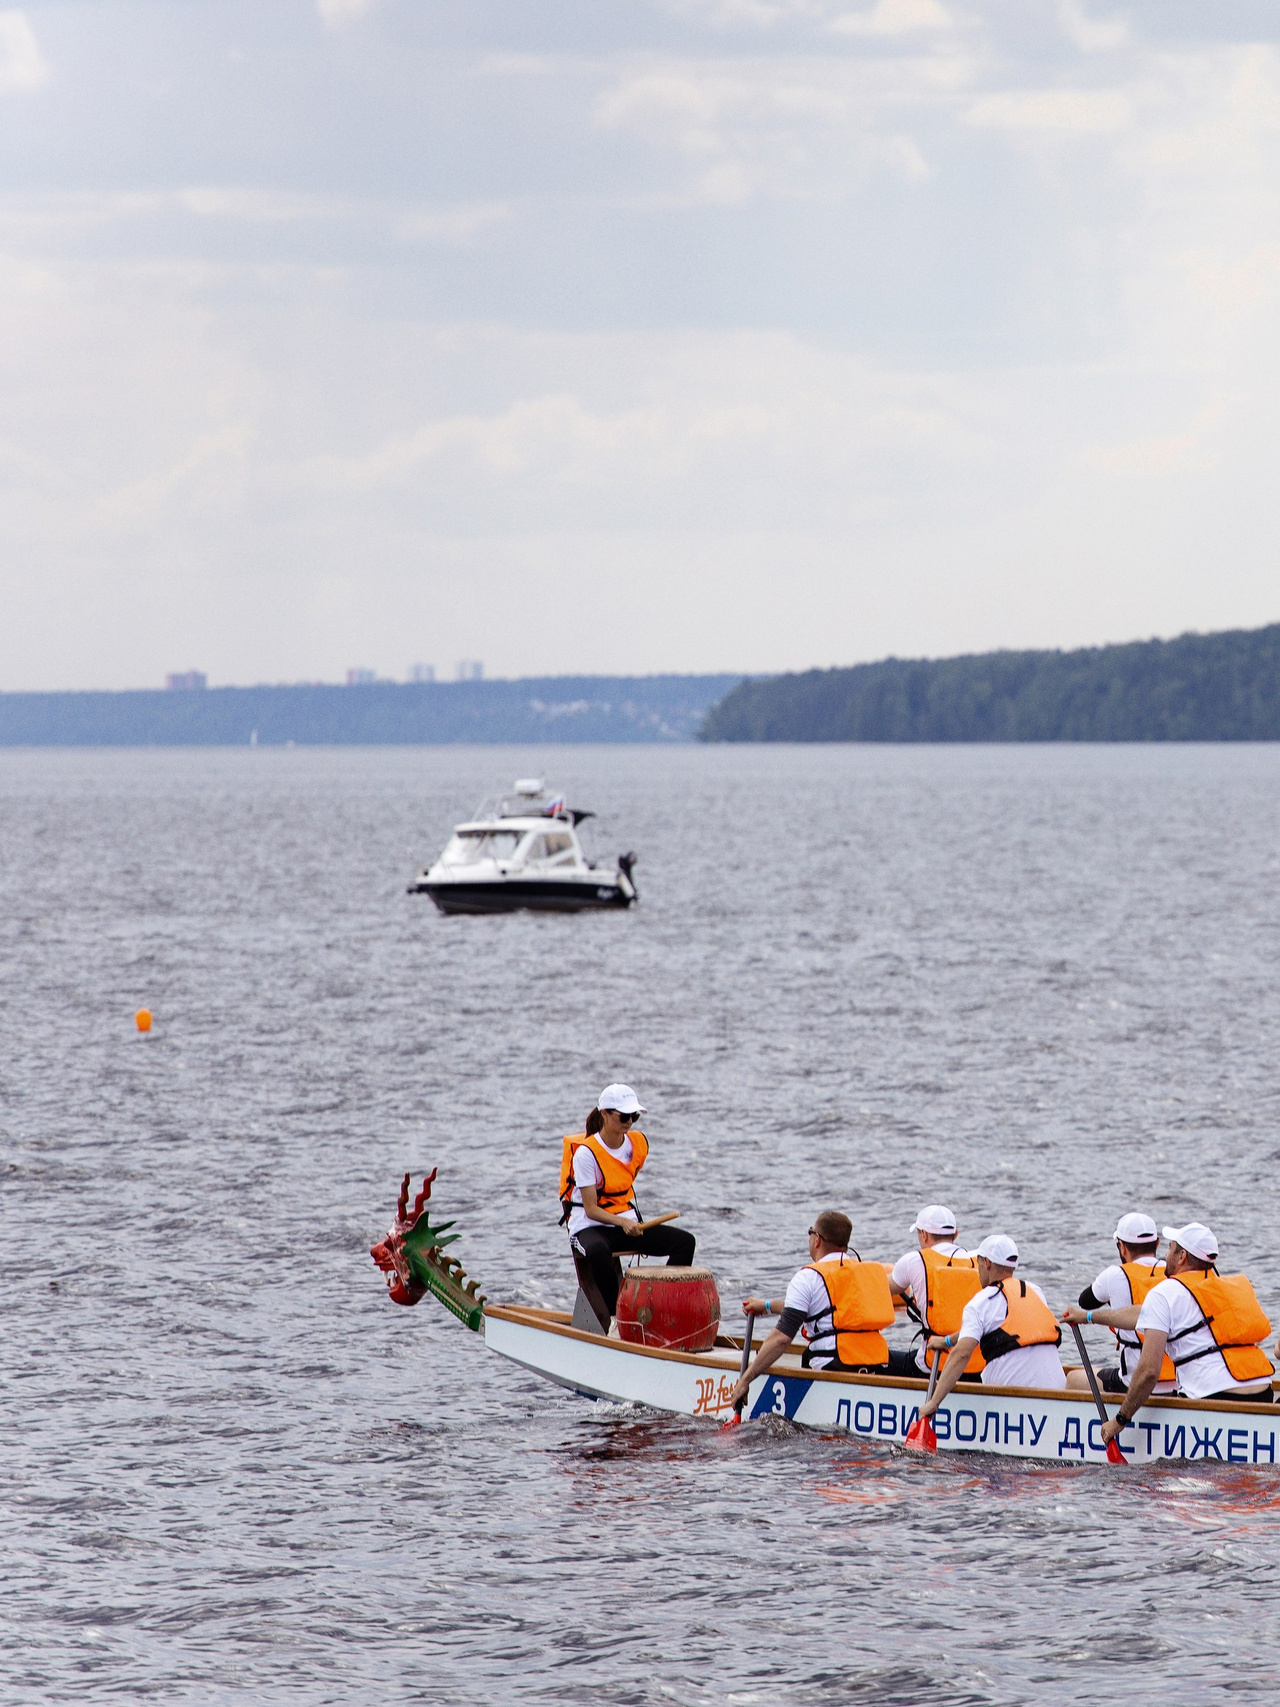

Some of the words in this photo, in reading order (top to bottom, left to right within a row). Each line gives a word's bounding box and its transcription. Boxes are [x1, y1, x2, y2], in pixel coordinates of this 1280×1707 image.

[772, 1381, 786, 1417] 3
[836, 1398, 920, 1437] ЛОВИ
[930, 1407, 1047, 1446] ВОЛНУ
